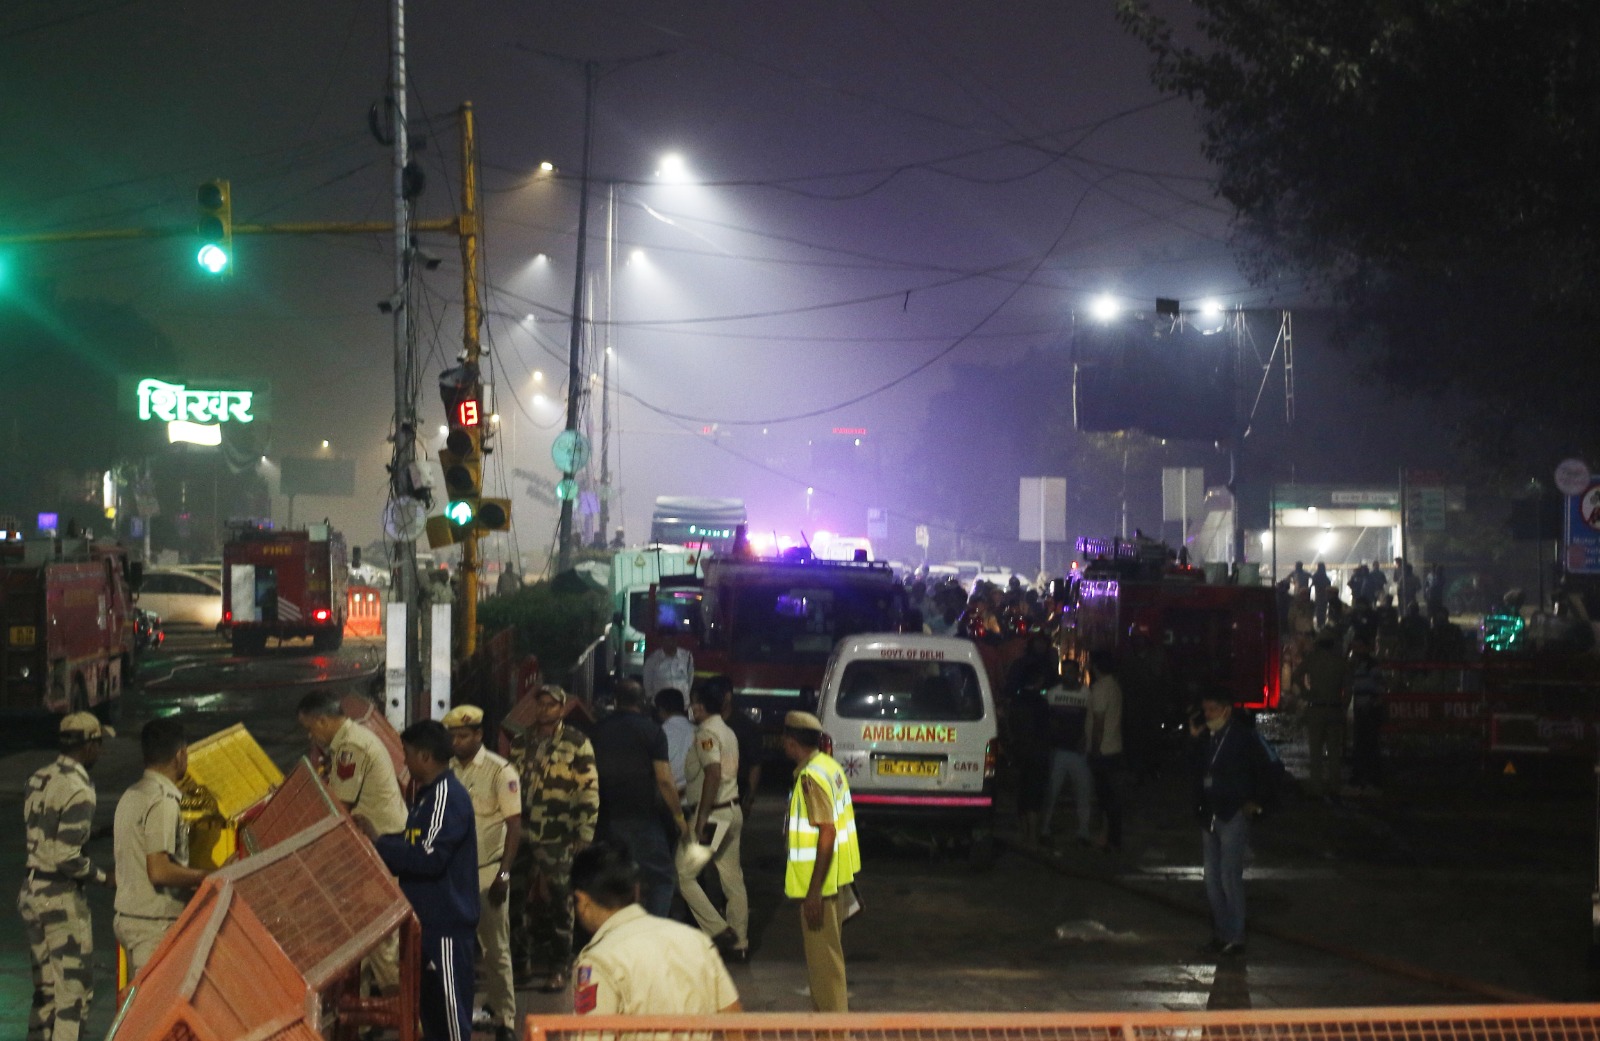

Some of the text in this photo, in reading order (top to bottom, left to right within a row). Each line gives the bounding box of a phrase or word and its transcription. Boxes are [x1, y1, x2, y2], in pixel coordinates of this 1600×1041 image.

[460, 400, 478, 425] 13
[880, 649, 944, 660] GOVT. OF DELHI
[1389, 701, 1484, 719] DELHI POLIC
[862, 725, 956, 742] AMBULANCE
[953, 761, 979, 772] CATS
